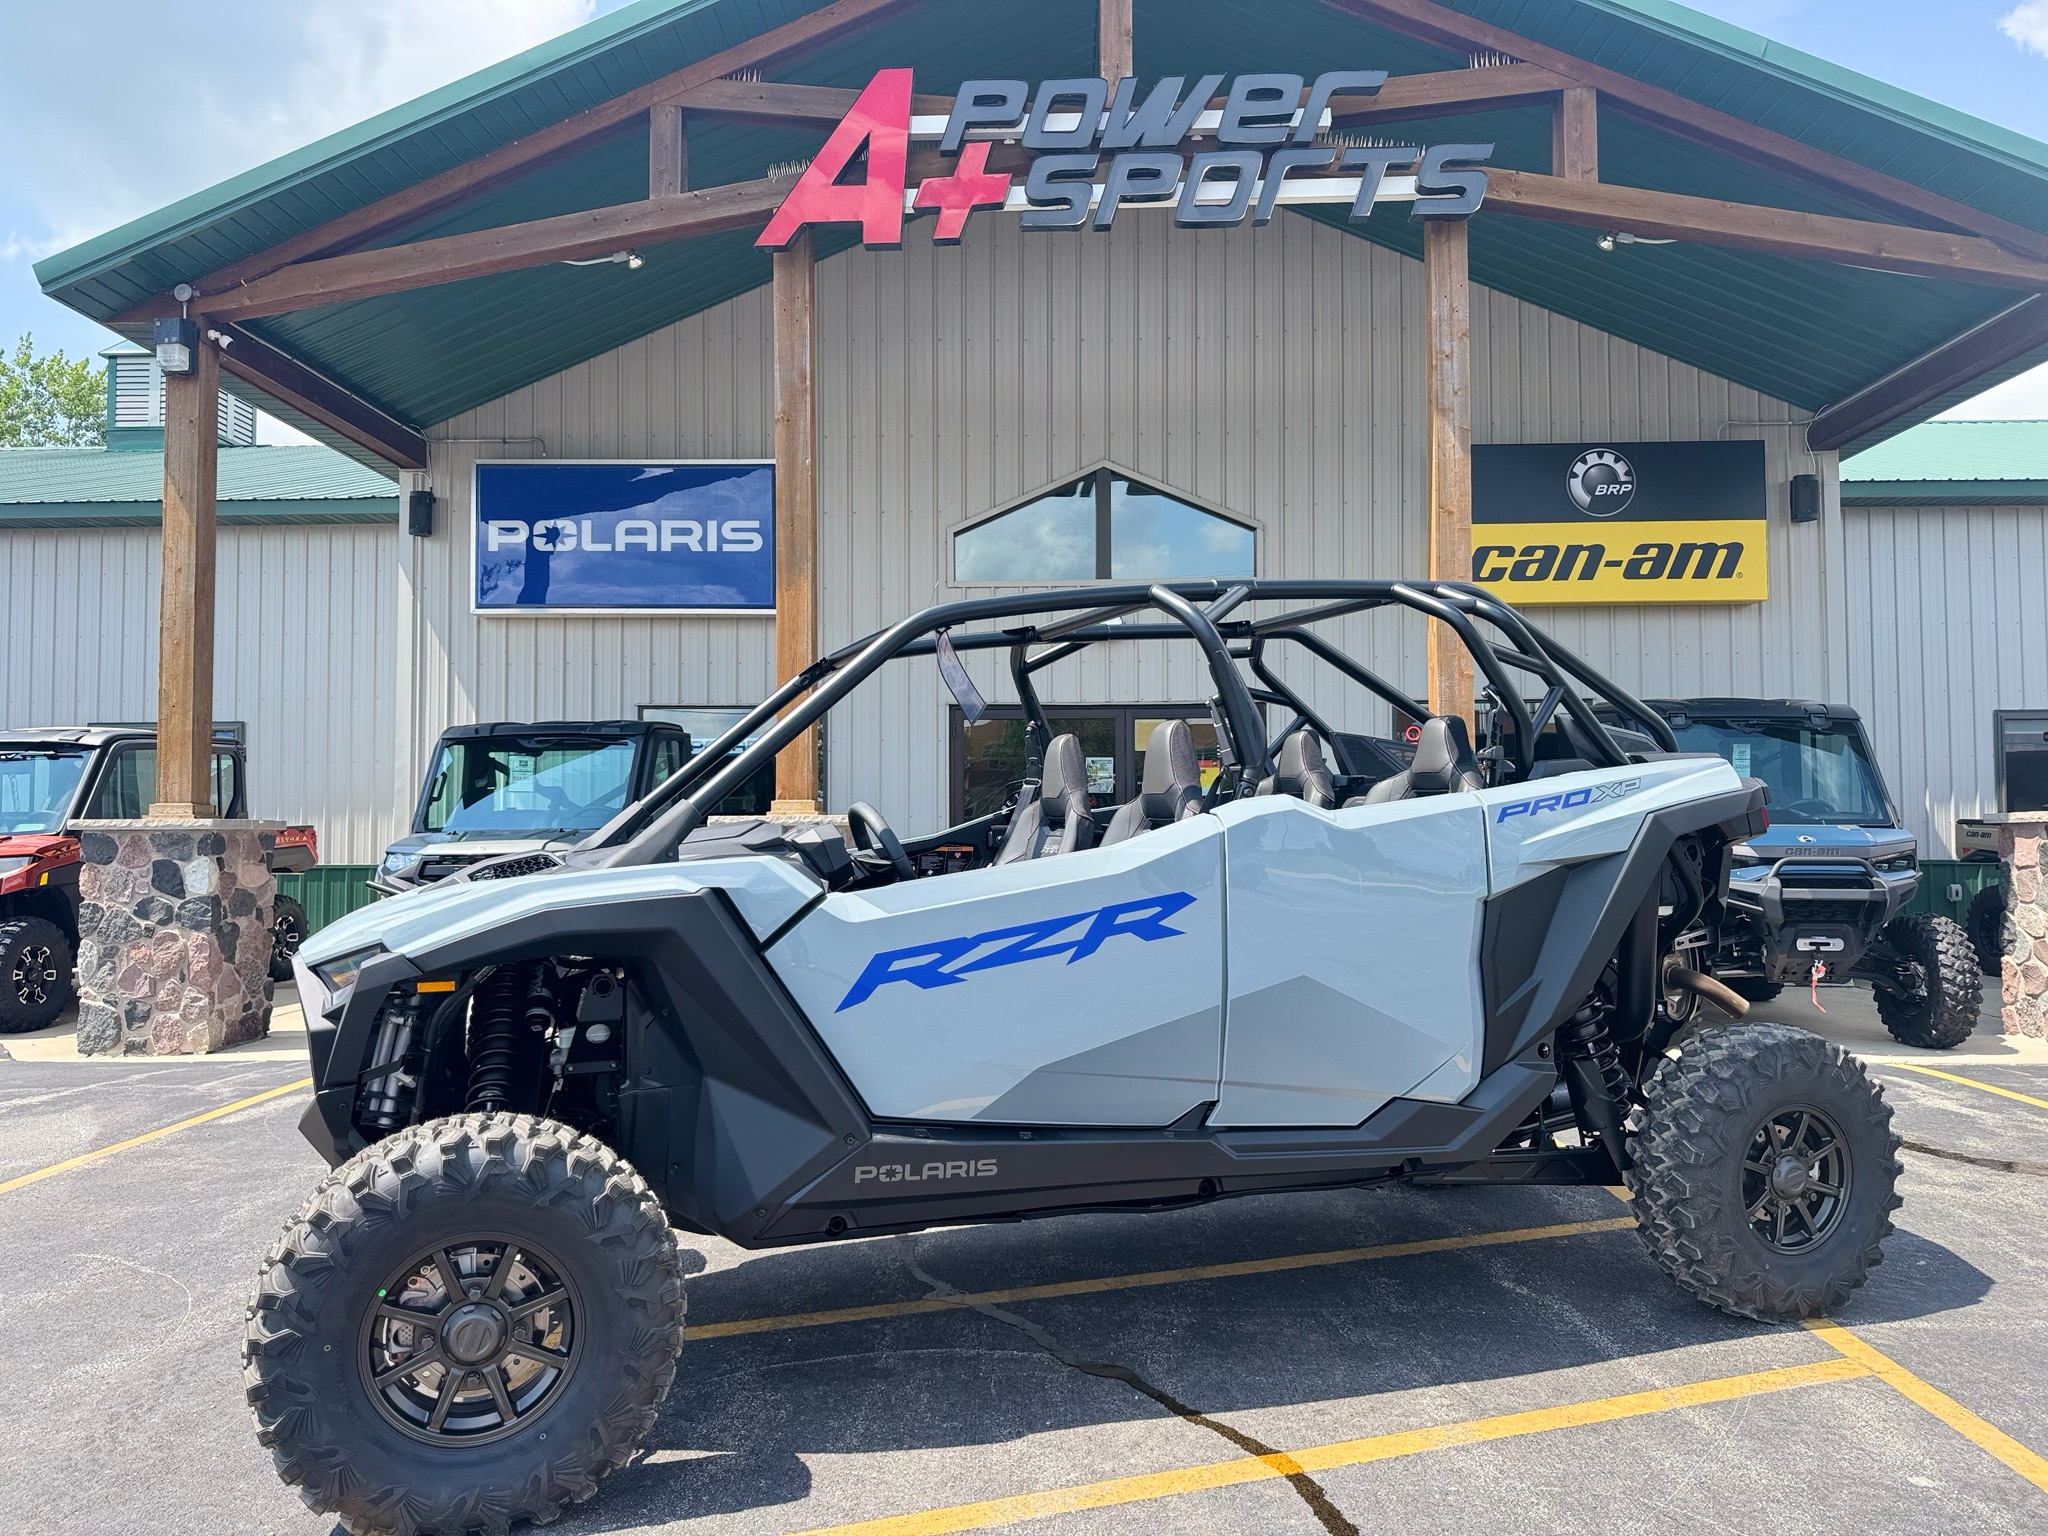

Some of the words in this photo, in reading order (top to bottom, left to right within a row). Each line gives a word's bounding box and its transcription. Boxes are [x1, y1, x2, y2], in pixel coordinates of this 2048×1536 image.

[754, 67, 1012, 249] A+
[1594, 483, 1633, 496] BRP
[487, 520, 763, 552] POLARIS
[1472, 541, 1744, 582] can-am
[1496, 788, 1593, 824] PRO
[1591, 778, 1641, 804] XP
[1966, 831, 1992, 839] can-am
[1785, 847, 1841, 856] can-am
[833, 891, 1198, 1014] RZR
[854, 1158, 998, 1184] POLARIS
